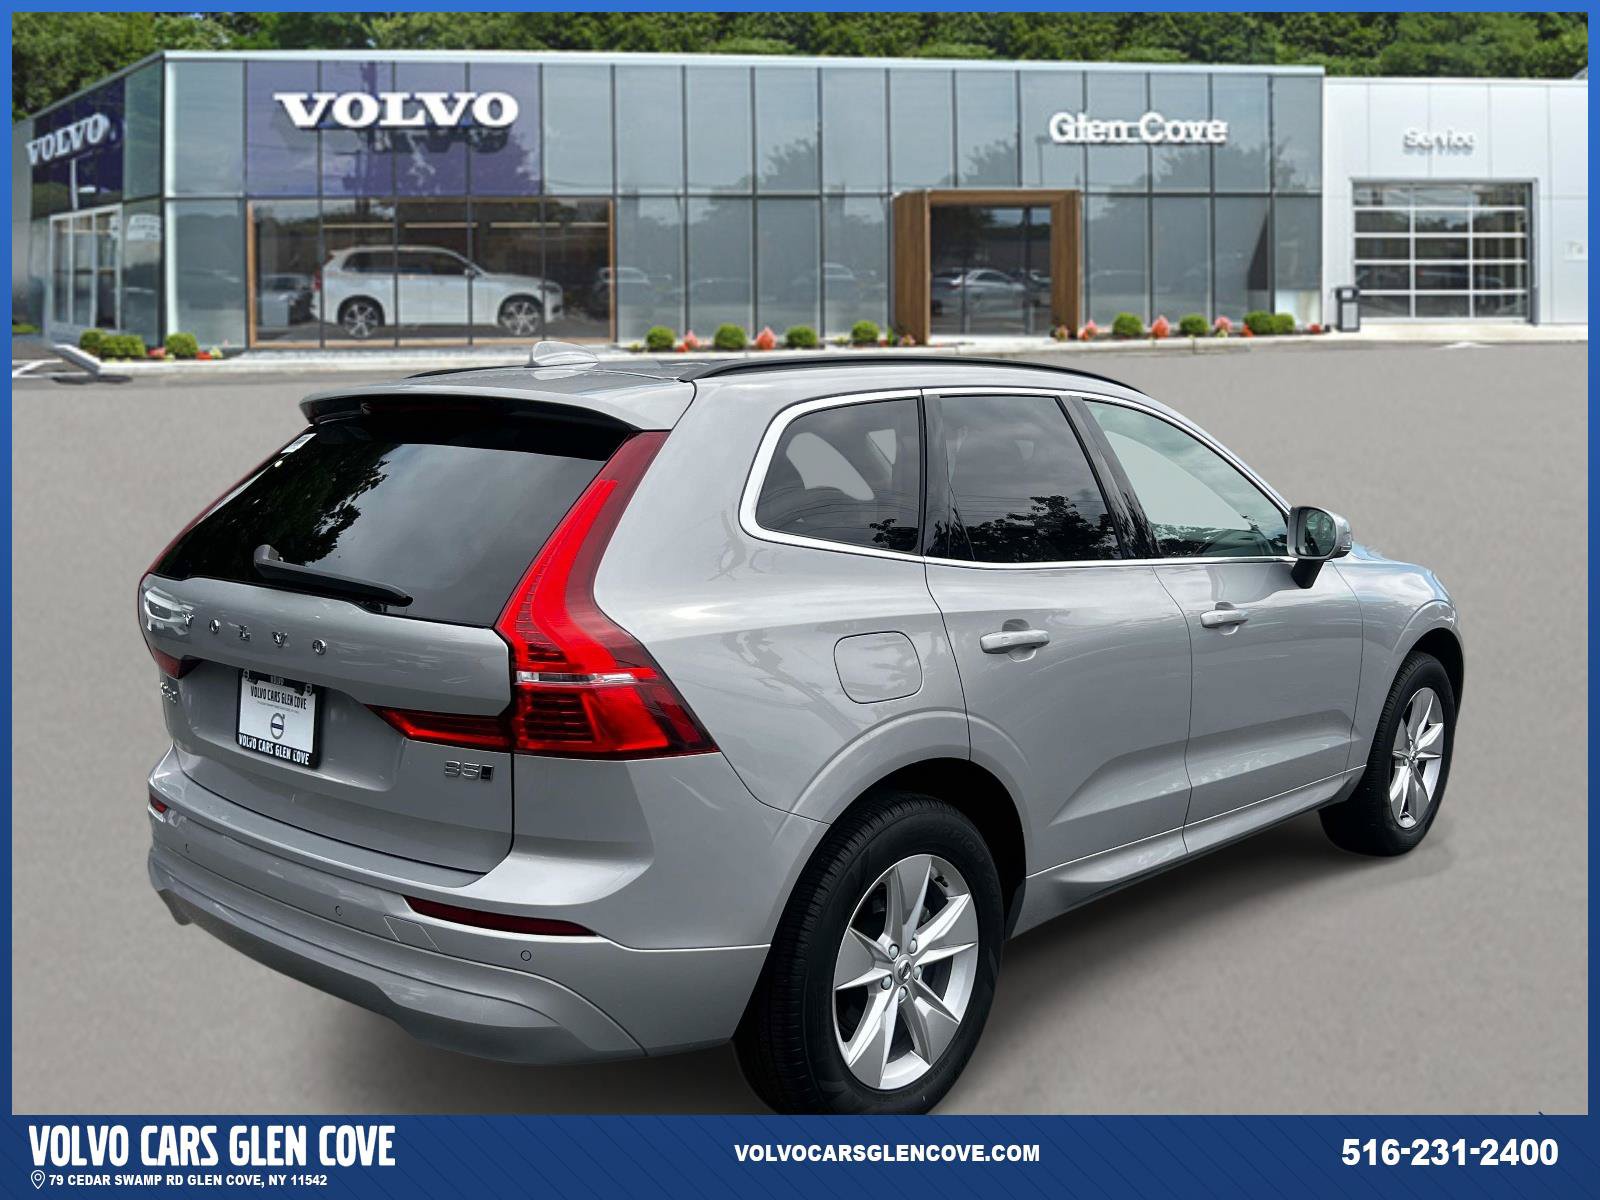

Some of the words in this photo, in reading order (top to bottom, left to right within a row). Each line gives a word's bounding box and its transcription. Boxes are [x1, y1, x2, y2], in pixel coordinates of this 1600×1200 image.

[274, 92, 520, 129] VOLVO
[26, 112, 110, 166] VOLVO
[1049, 112, 1131, 143] Glen
[1139, 112, 1228, 143] Cove
[1403, 127, 1475, 155] Service
[183, 612, 327, 656] VOLVO
[250, 685, 266, 700] VOLVO
[267, 689, 281, 704] CARS
[281, 692, 294, 707] GLEN
[294, 695, 307, 710] COVE
[239, 734, 257, 750] VOLVO
[258, 739, 274, 755] CARS
[275, 745, 291, 760] GLEN
[293, 750, 310, 765] COVE
